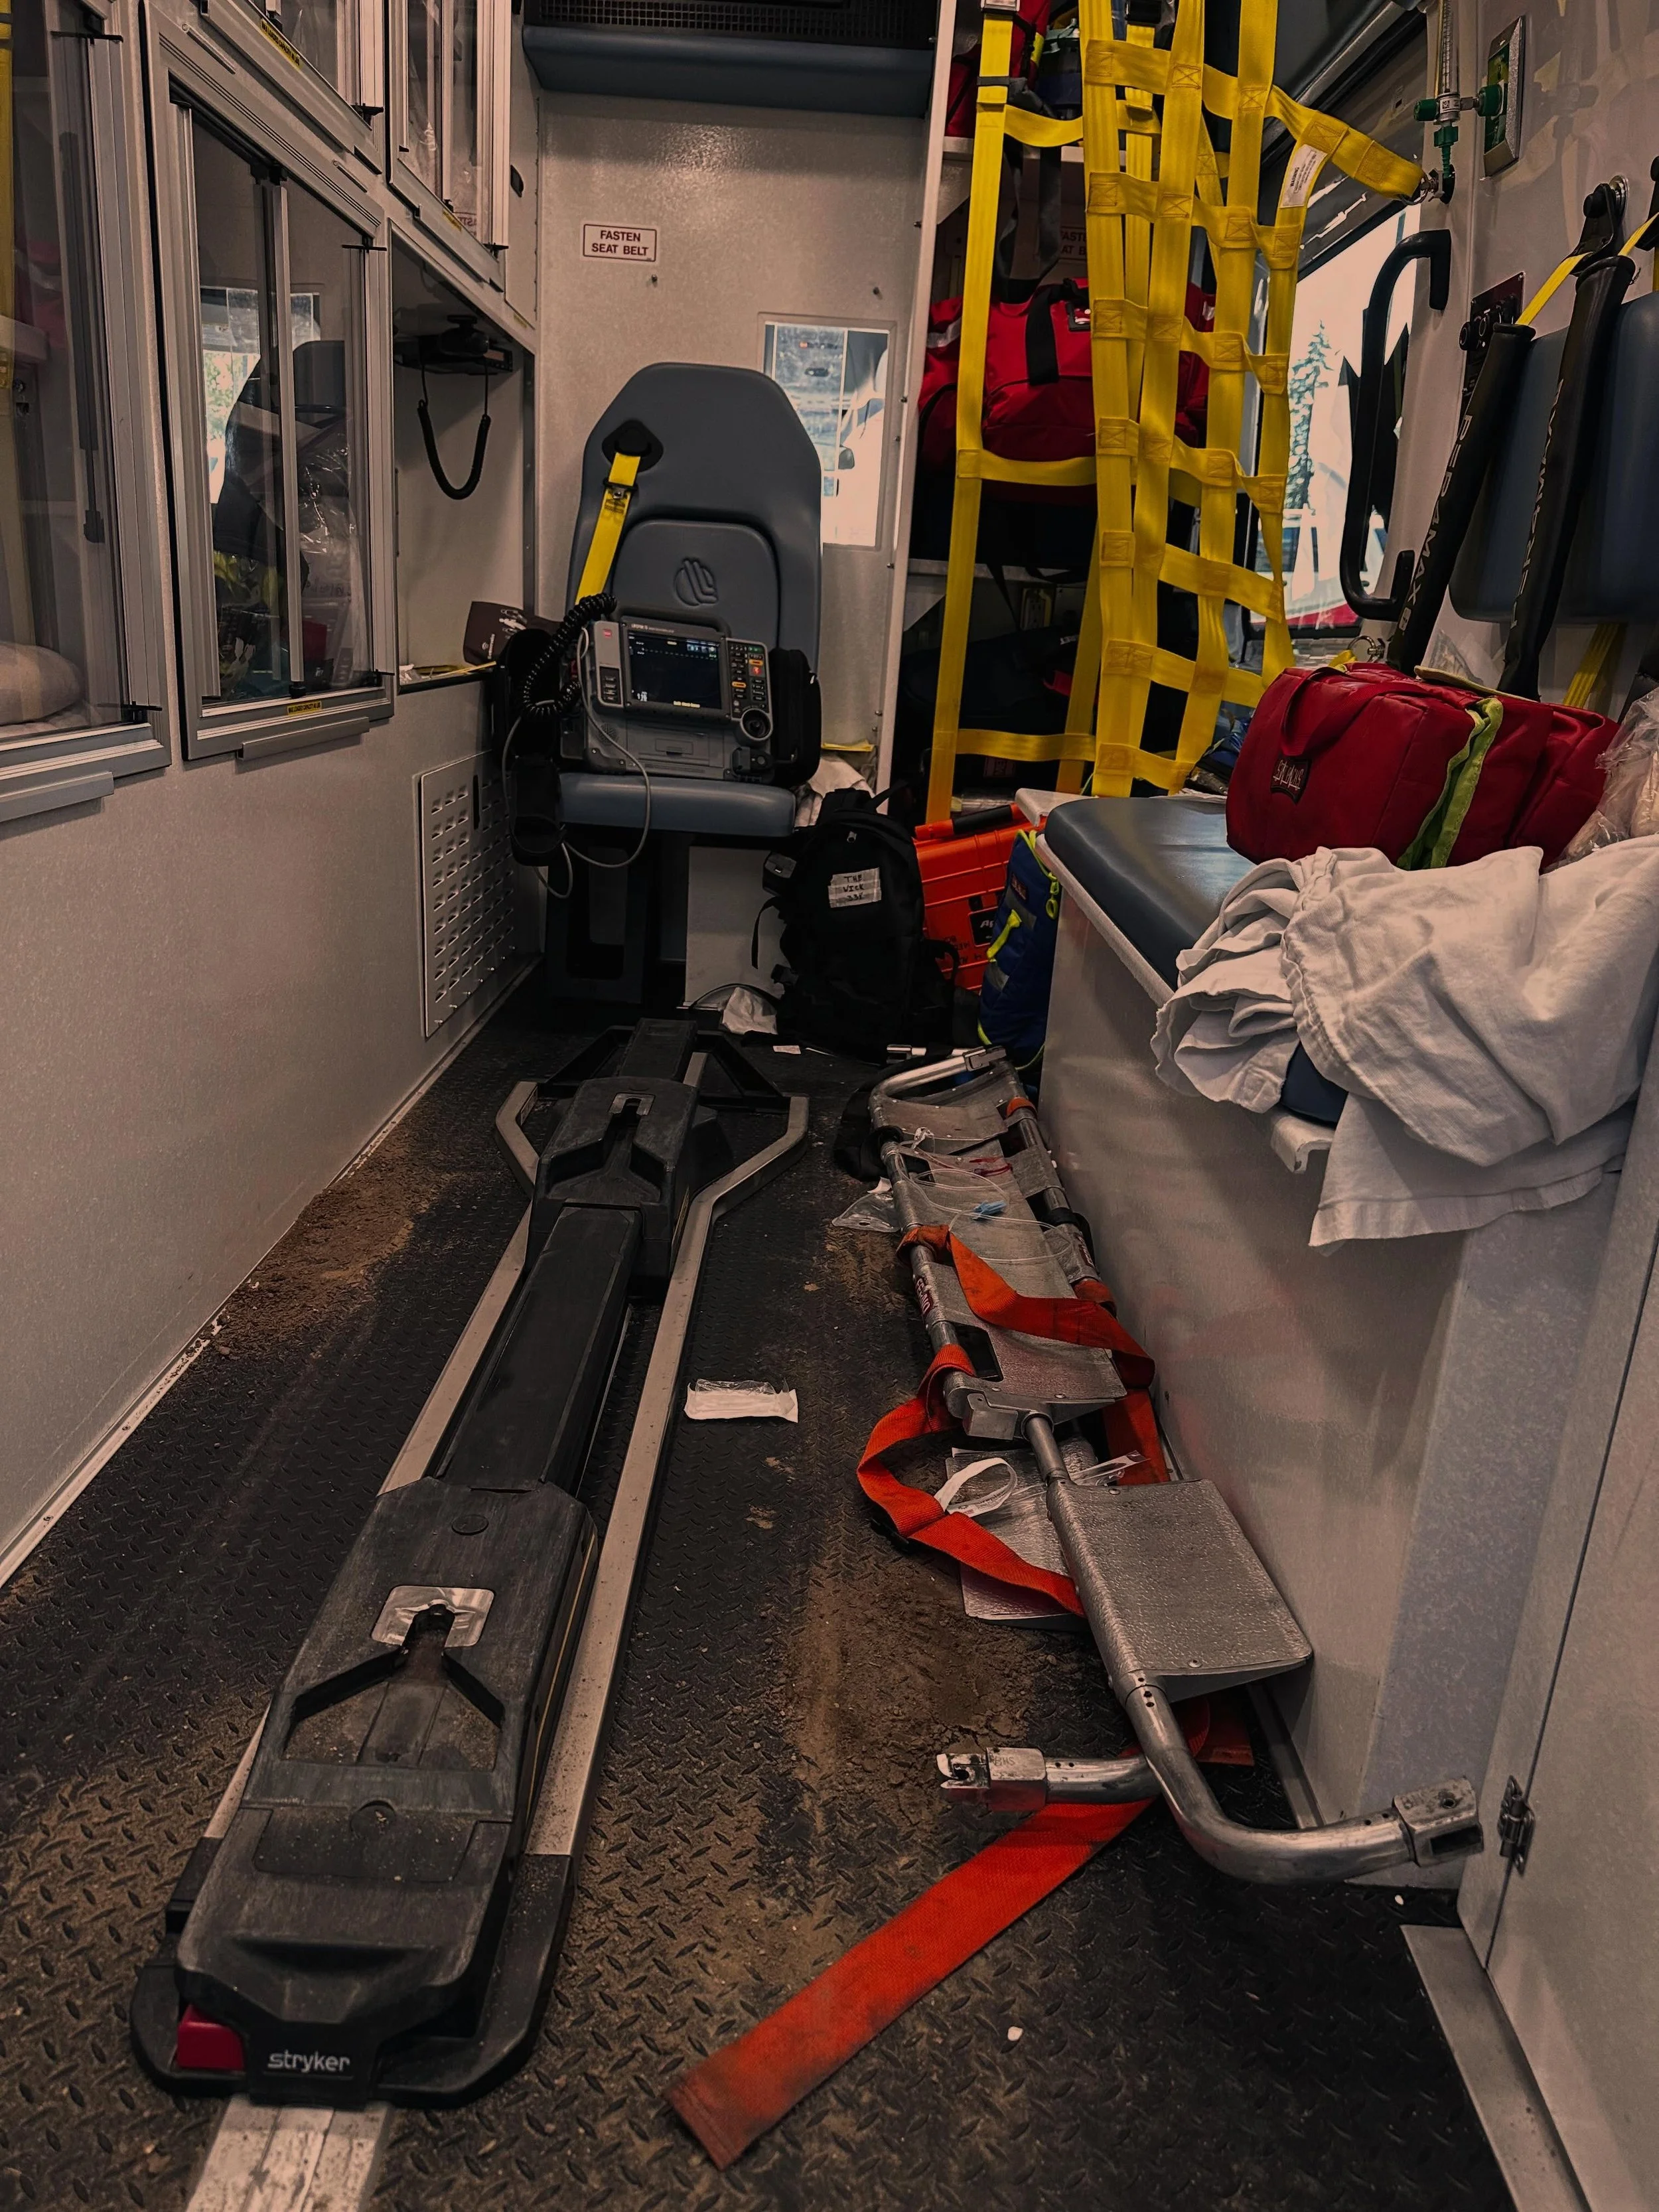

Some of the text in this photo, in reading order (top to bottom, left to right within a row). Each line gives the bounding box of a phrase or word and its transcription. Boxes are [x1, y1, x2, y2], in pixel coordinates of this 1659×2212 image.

[601, 230, 640, 242] FASTEN
[592, 243, 650, 256] SEAT BELT
[844, 874, 862, 883] THE
[267, 2049, 351, 2074] stryker
